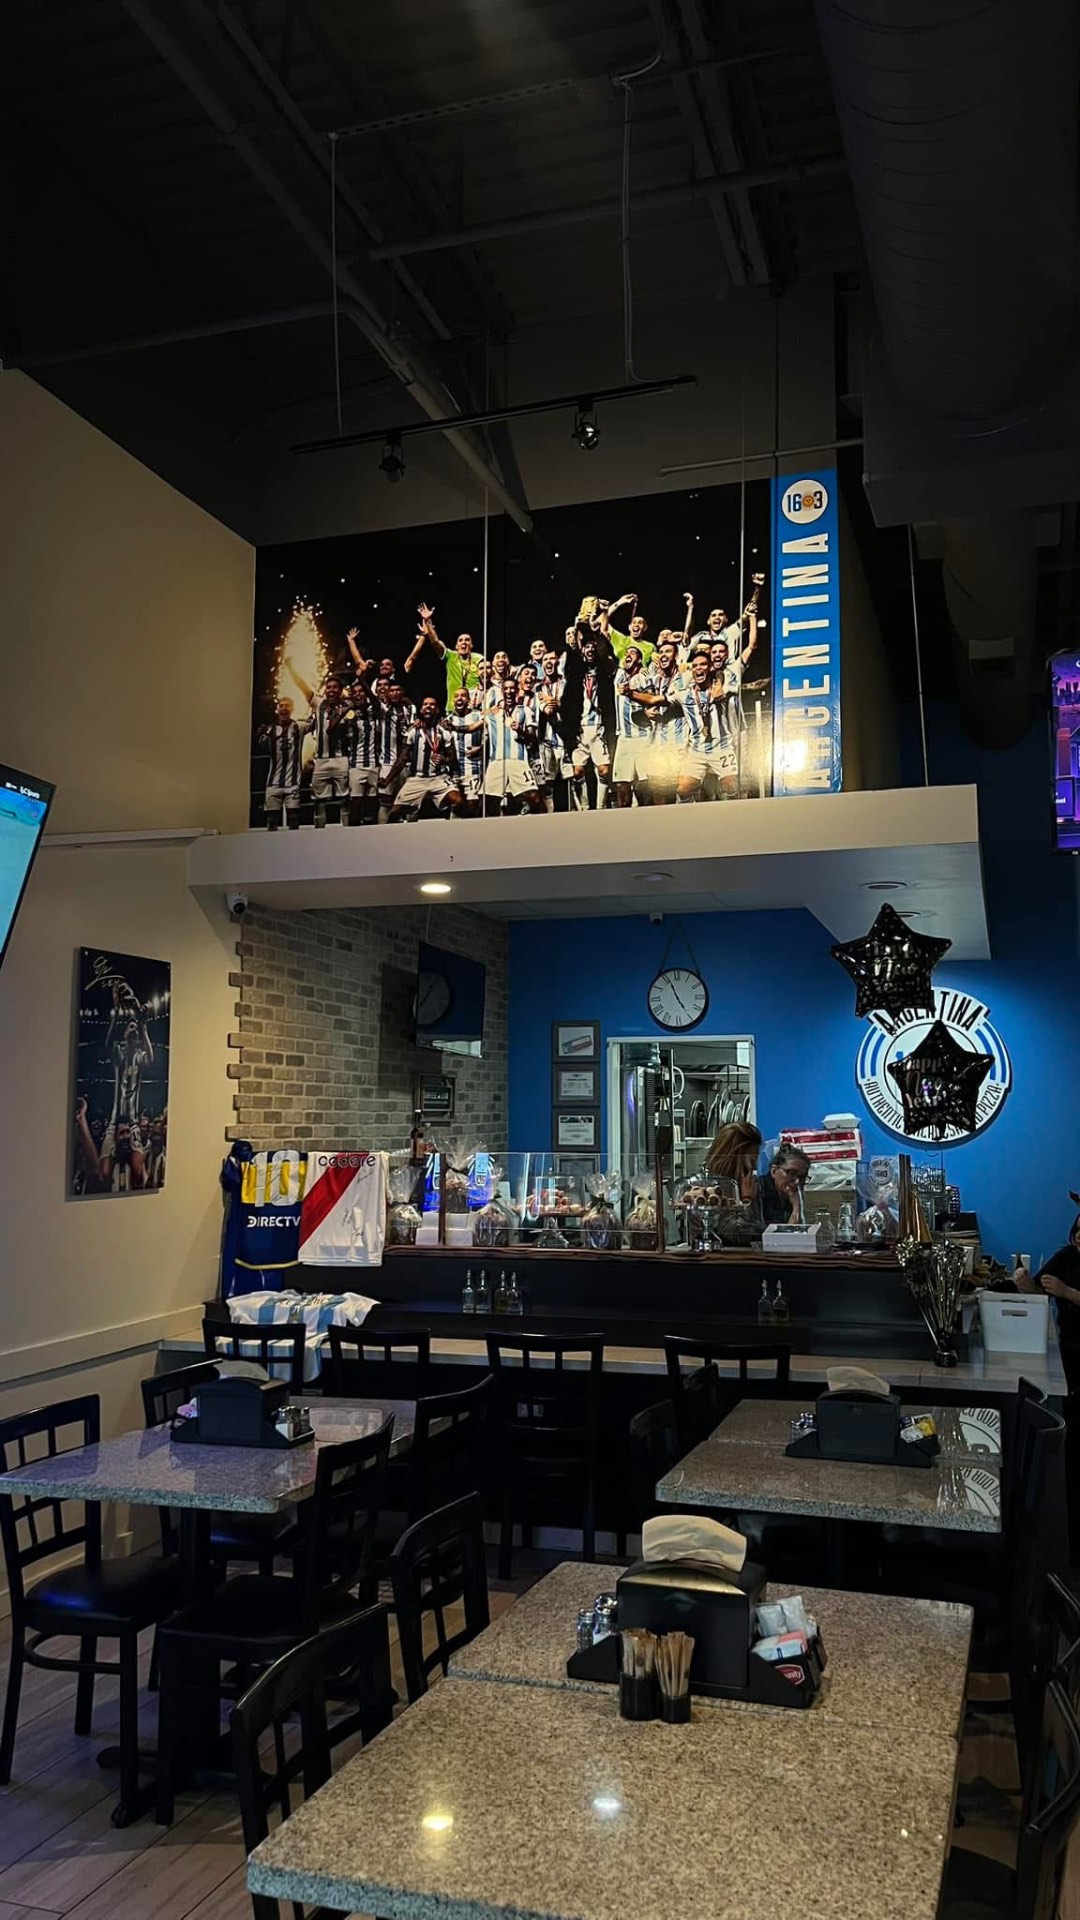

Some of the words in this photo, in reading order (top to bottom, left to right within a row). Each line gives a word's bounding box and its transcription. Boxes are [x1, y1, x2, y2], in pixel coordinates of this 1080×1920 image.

[720, 754, 737, 768] 22
[864, 1081, 905, 1129] AUTHENTIC
[976, 1084, 1003, 1116] PIZZA
[317, 1155, 377, 1168] codere
[250, 1149, 300, 1208] 10
[246, 1214, 301, 1228] DIRECTV
